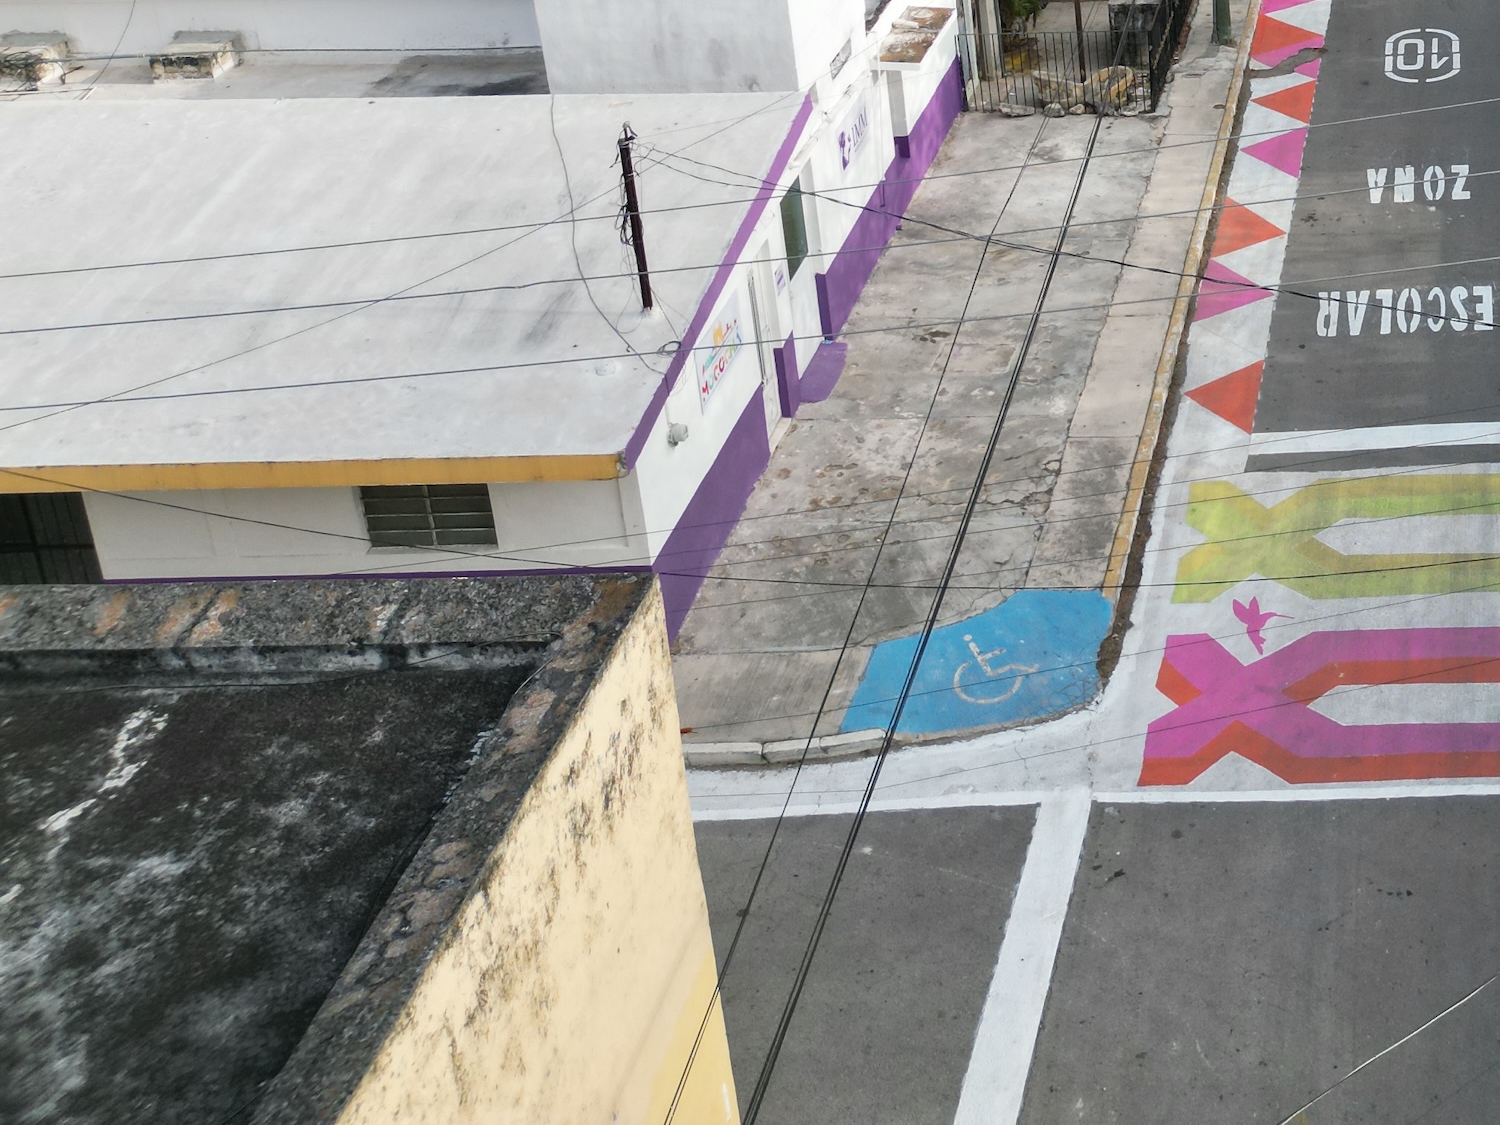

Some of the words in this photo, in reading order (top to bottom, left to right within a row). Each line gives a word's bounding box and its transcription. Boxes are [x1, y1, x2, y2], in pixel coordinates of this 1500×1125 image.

[1396, 37, 1450, 71] 10
[1367, 164, 1471, 204] ZONA
[1316, 286, 1494, 338] ESCOLAR
